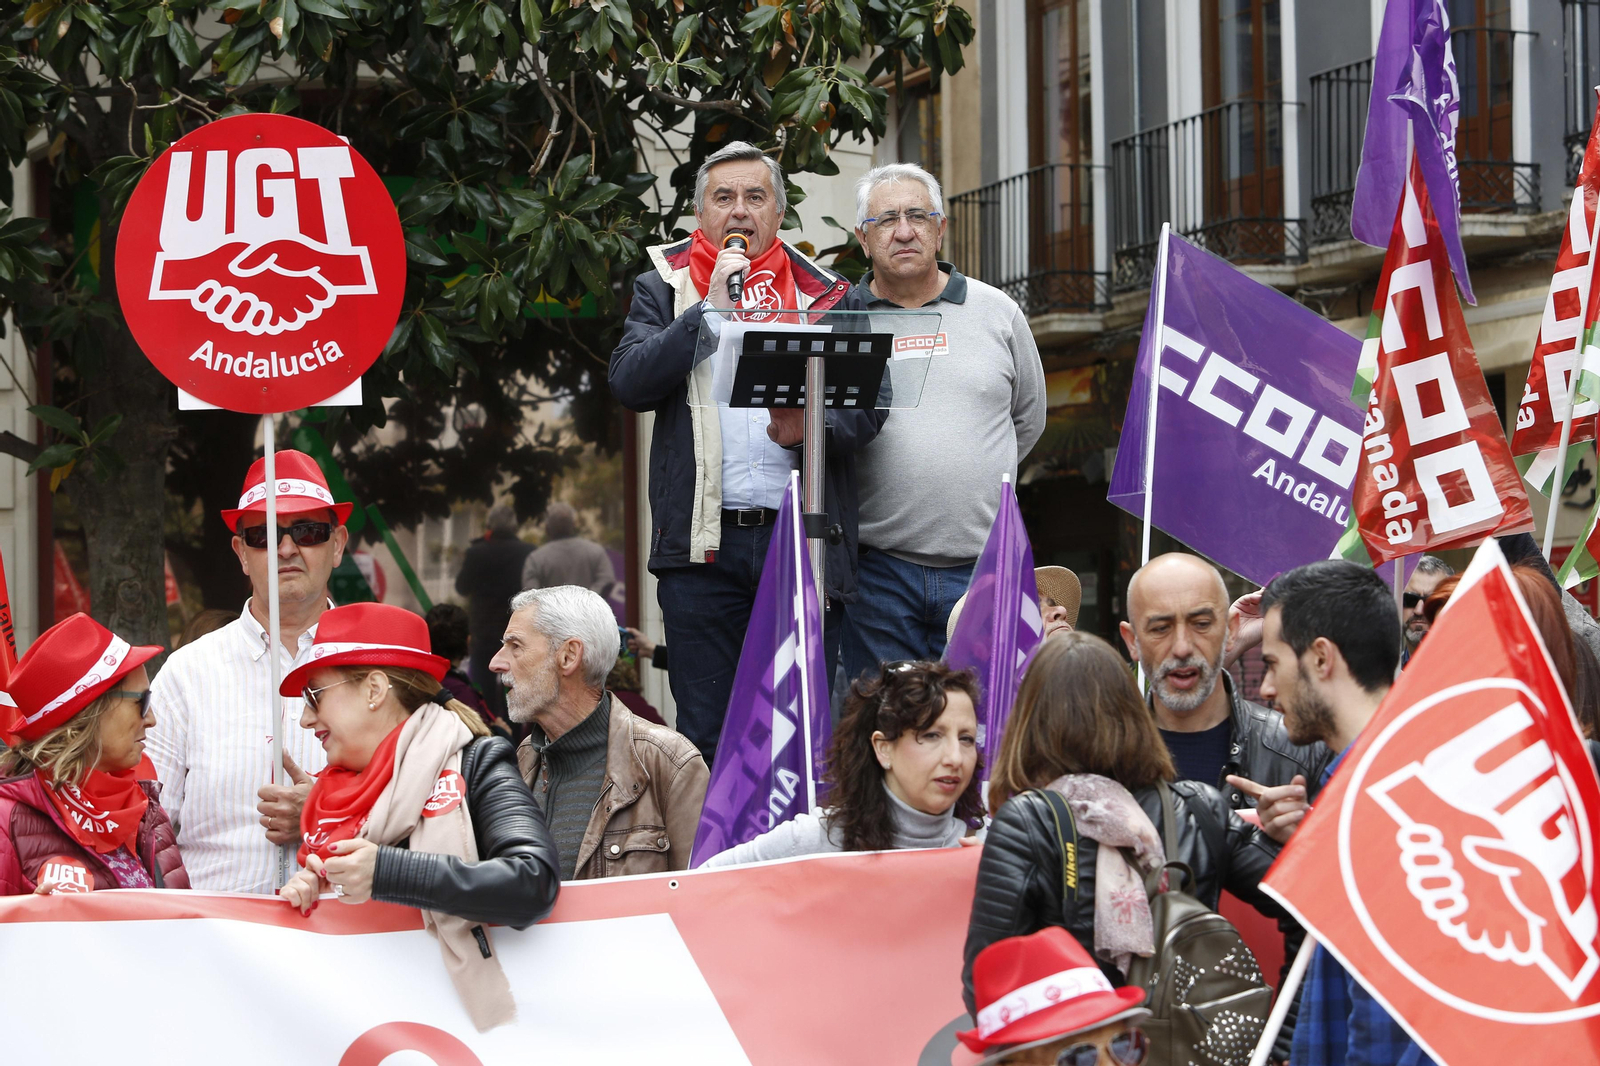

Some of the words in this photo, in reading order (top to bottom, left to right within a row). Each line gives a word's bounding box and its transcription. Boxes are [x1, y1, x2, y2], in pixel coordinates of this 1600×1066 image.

[159, 146, 355, 256] UGT
[188, 339, 344, 379] Andalucía
[897, 337, 935, 350] CCOO
[1159, 324, 1364, 490] CCOO
[432, 773, 459, 793] GT
[44, 863, 87, 887] UGT
[1066, 841, 1077, 889] Nikon
